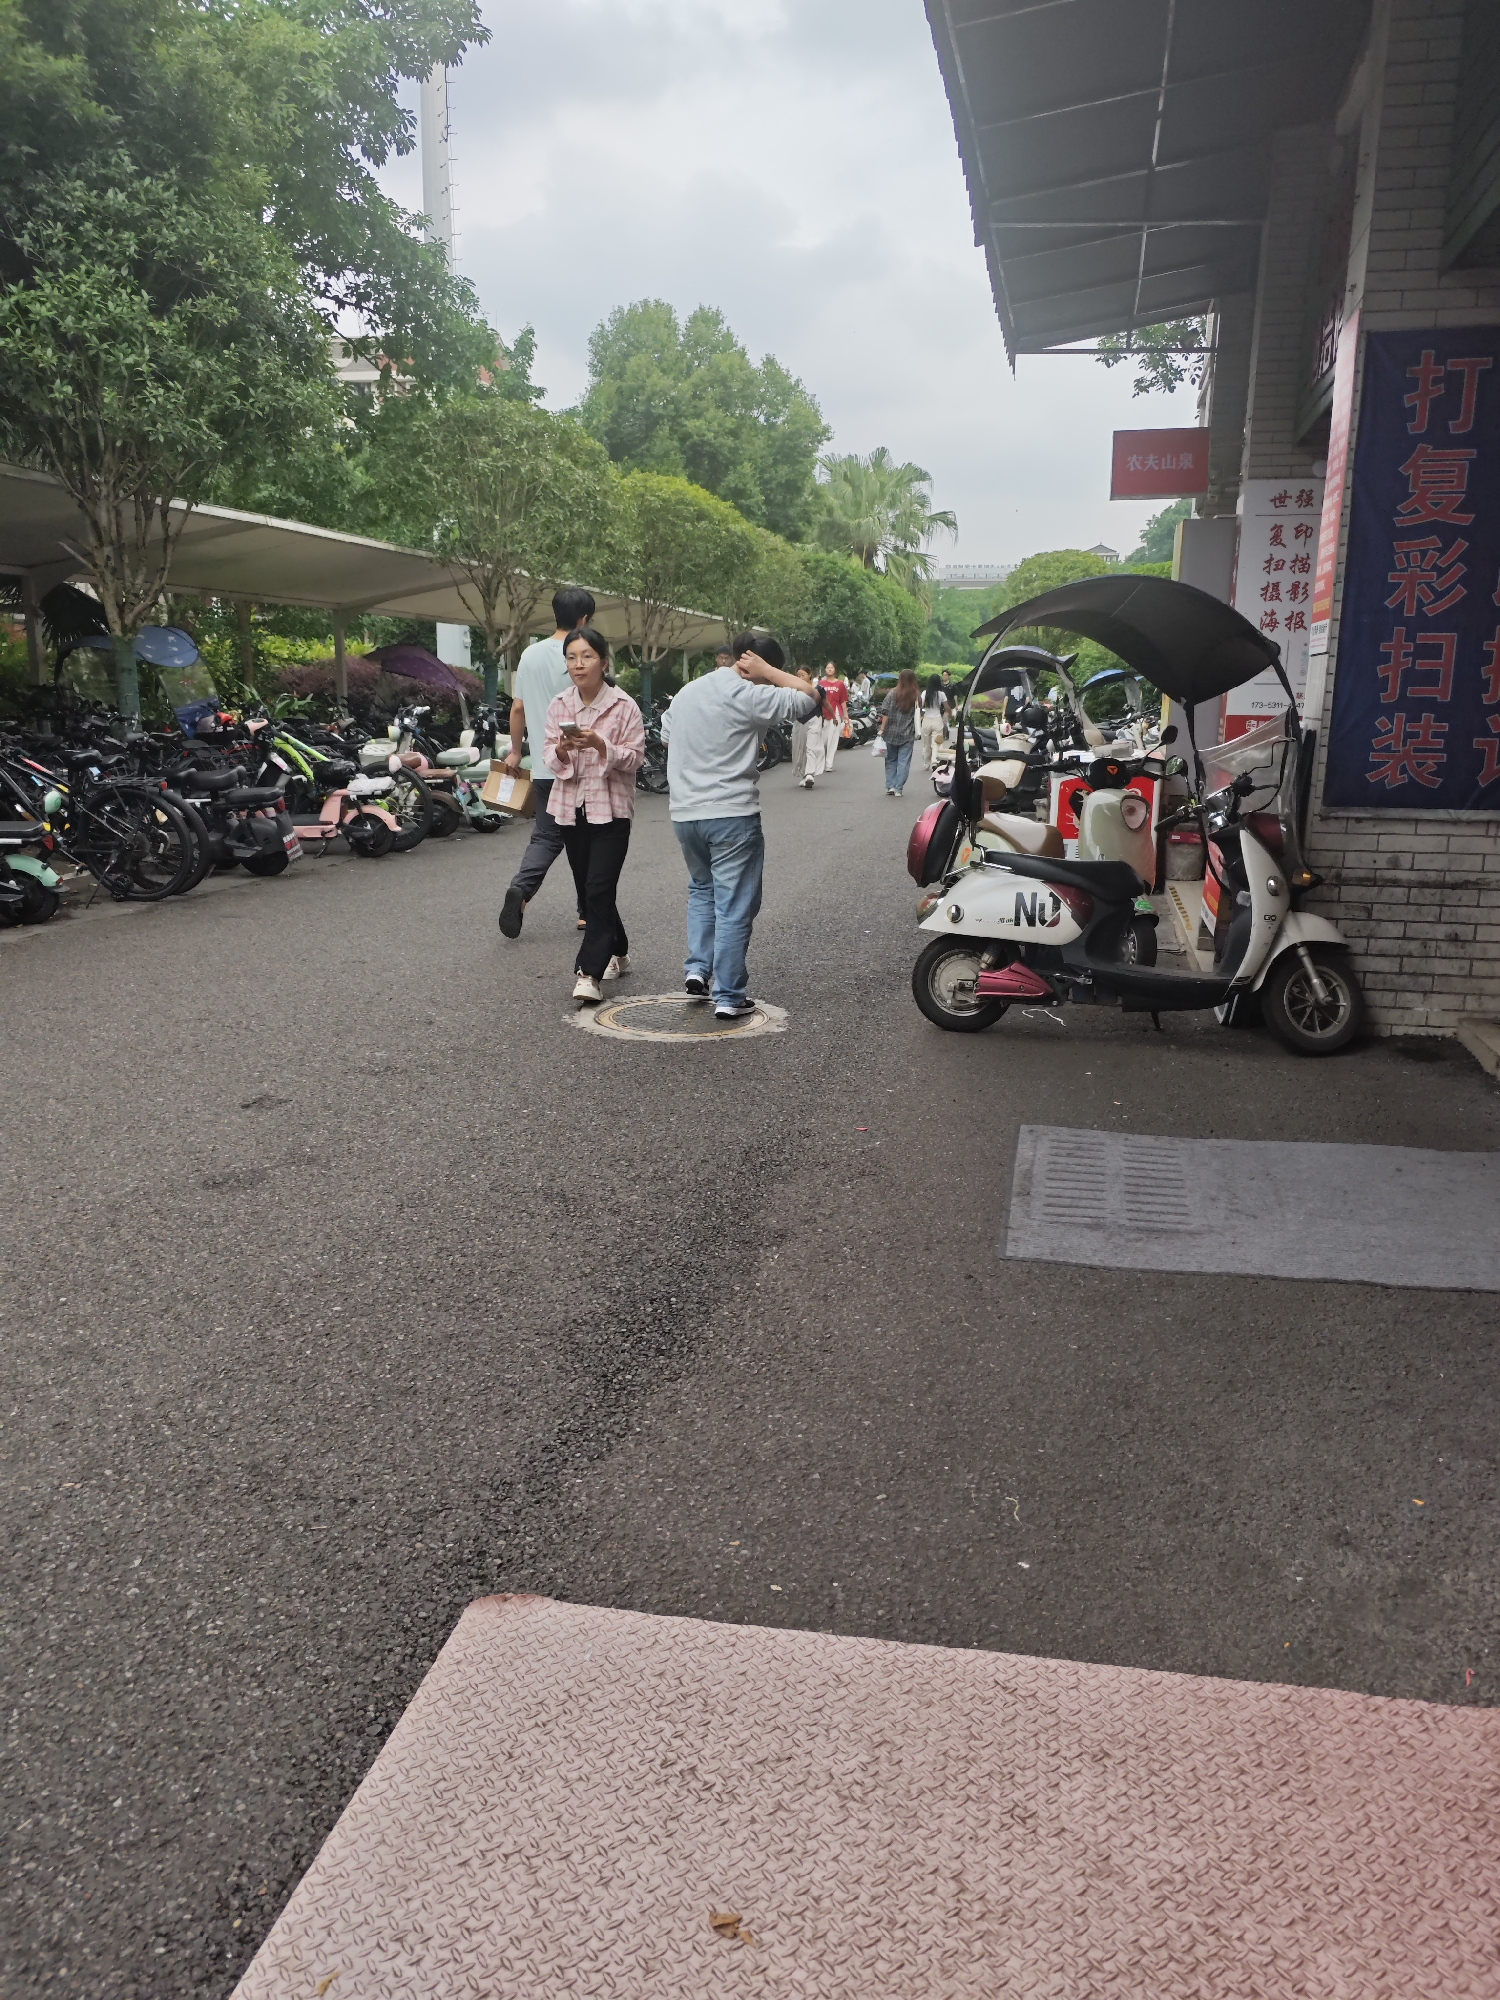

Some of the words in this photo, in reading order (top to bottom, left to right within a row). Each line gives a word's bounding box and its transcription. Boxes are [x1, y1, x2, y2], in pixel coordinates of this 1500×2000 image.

[1126, 452, 1194, 472] 农夫山泉
[1269, 488, 1314, 508] 世强
[1269, 522, 1314, 549] 复印
[1262, 552, 1311, 575] 扫描
[1260, 580, 1309, 604] 摄影
[1259, 608, 1308, 633] 海报
